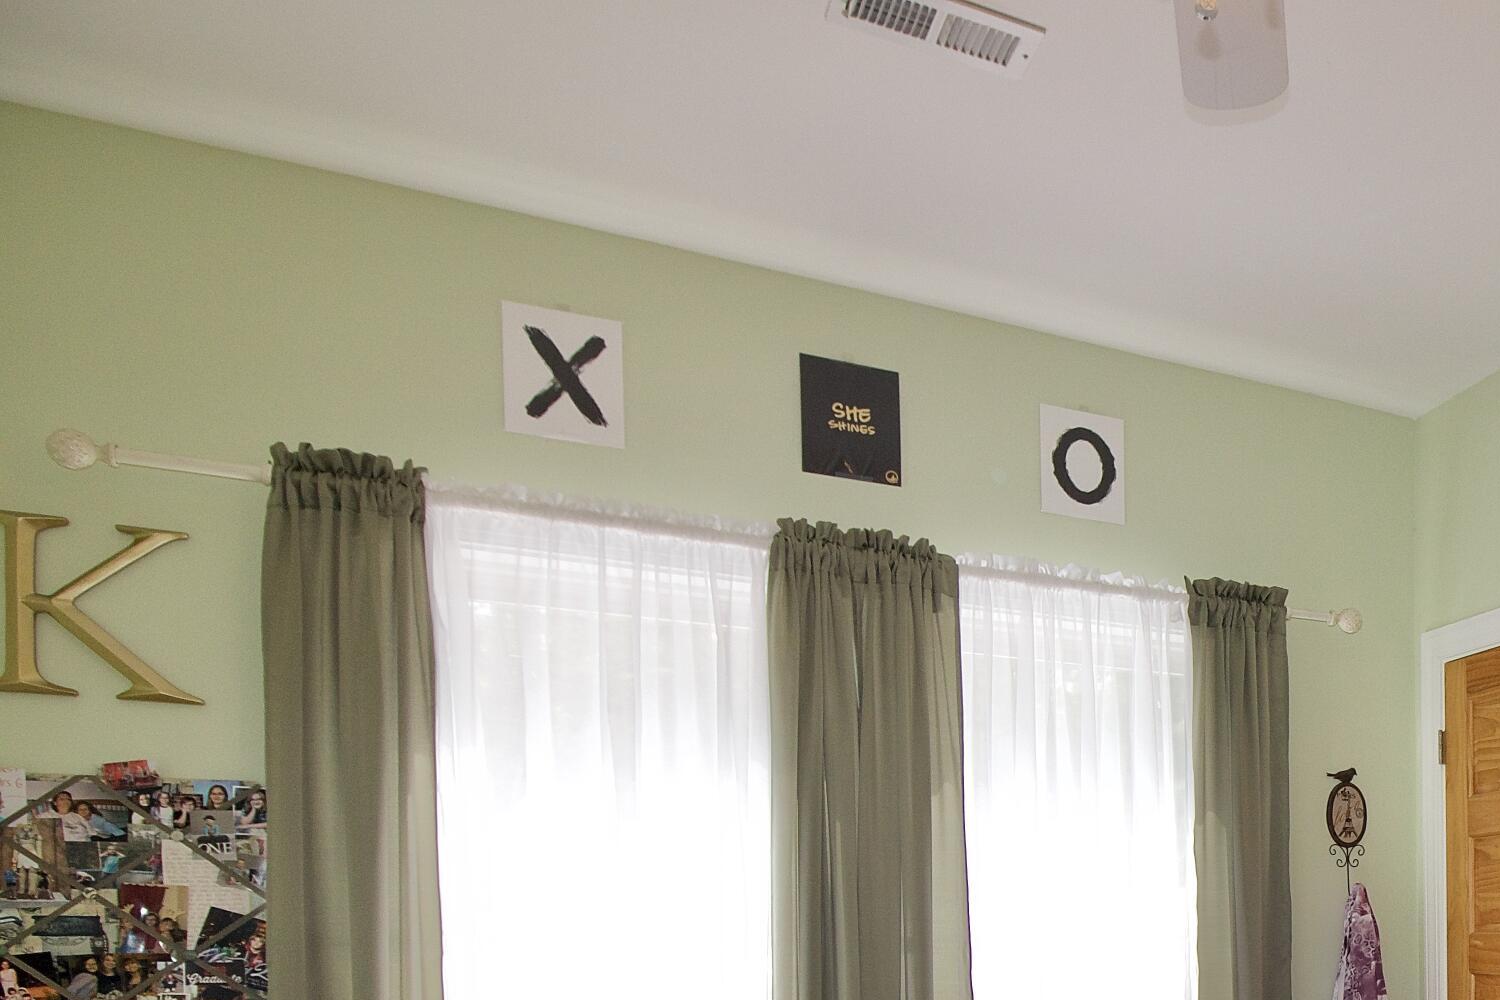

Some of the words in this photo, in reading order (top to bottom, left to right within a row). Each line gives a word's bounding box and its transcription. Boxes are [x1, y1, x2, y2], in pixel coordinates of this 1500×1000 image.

[522, 324, 608, 428] X
[831, 402, 871, 423] SHE
[0, 509, 206, 706] K
